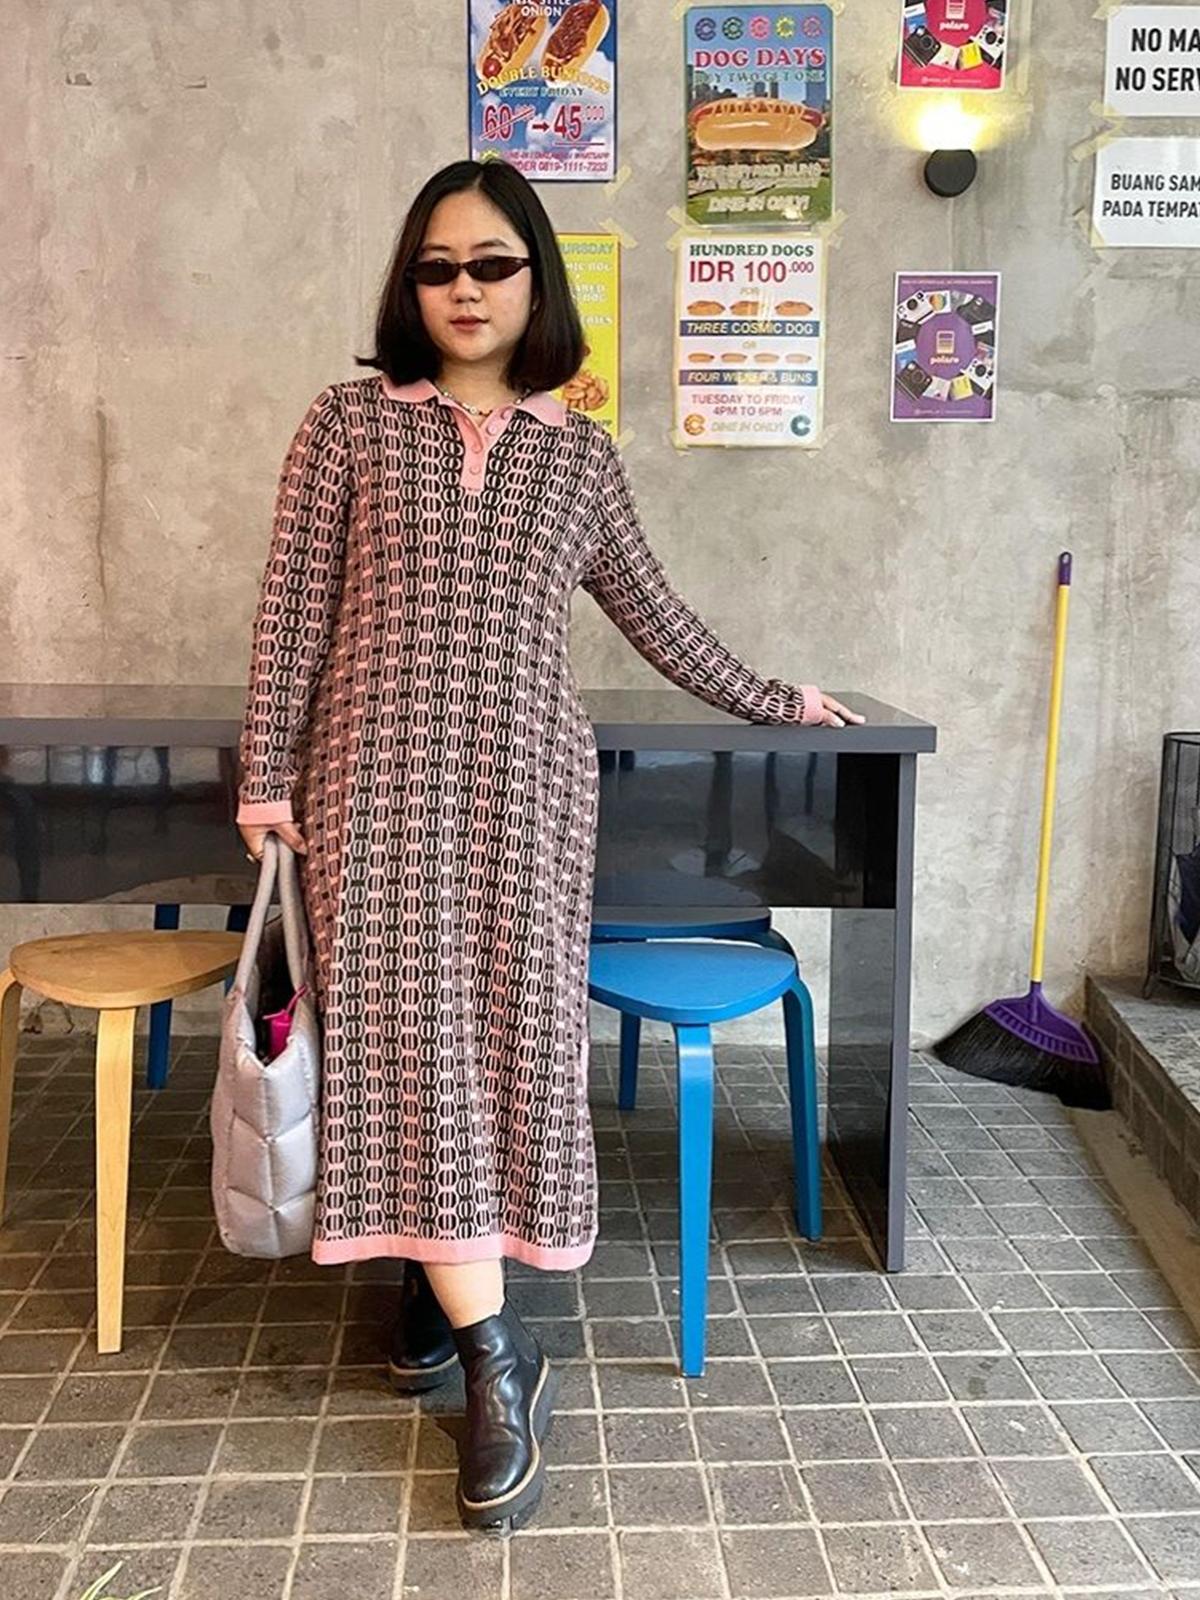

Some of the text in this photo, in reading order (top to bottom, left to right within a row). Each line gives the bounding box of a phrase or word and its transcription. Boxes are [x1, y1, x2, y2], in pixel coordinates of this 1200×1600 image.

[521, 6, 562, 17] ONION
[1131, 28, 1200, 52] NO MA
[694, 47, 825, 68] DOG DAYS
[476, 66, 538, 96] DOUBLE
[1115, 67, 1200, 91] NO SER
[1111, 174, 1165, 191] BUANG
[1102, 201, 1200, 218] PADA TEMPA
[689, 244, 814, 257] HUNDRED DOGS
[690, 261, 734, 282] IDR
[687, 322, 728, 334] THREE
[785, 323, 814, 335] DOG
[687, 372, 720, 383] FOUR
[781, 372, 813, 384] BUNS
[691, 394, 806, 405] TUESDAY TO FRIDAY
[713, 406, 738, 416] 4PM
[740, 406, 756, 416] TO
